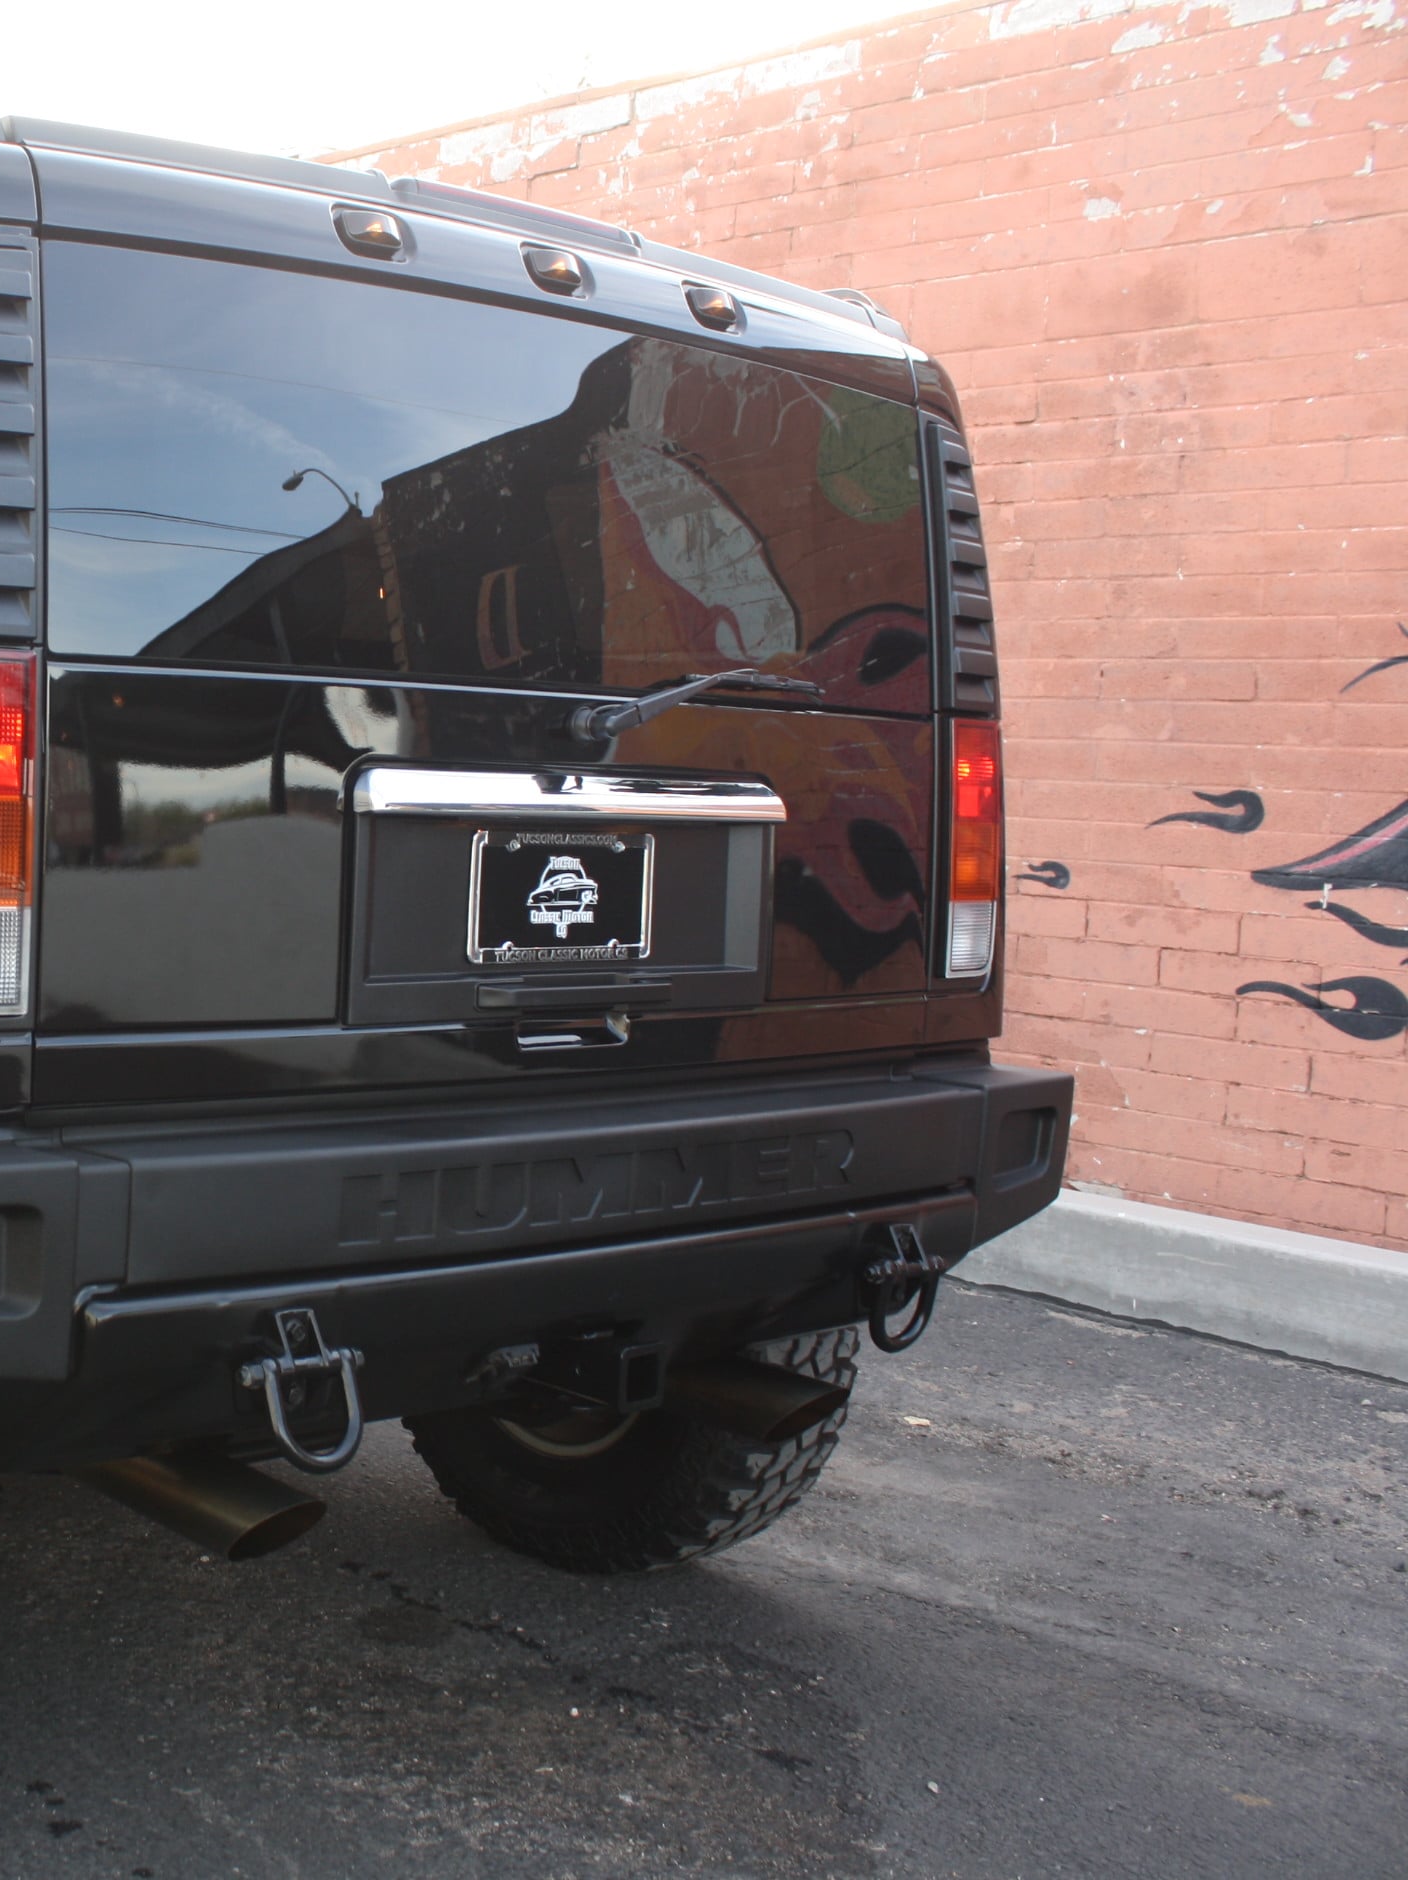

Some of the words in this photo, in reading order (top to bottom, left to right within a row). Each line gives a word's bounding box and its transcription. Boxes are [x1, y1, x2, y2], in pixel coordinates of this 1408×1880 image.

[494, 949, 536, 963] TUCSON
[537, 949, 579, 962] CLASSIC
[580, 948, 614, 961] MOTOR
[338, 1128, 855, 1247] HUMMER
